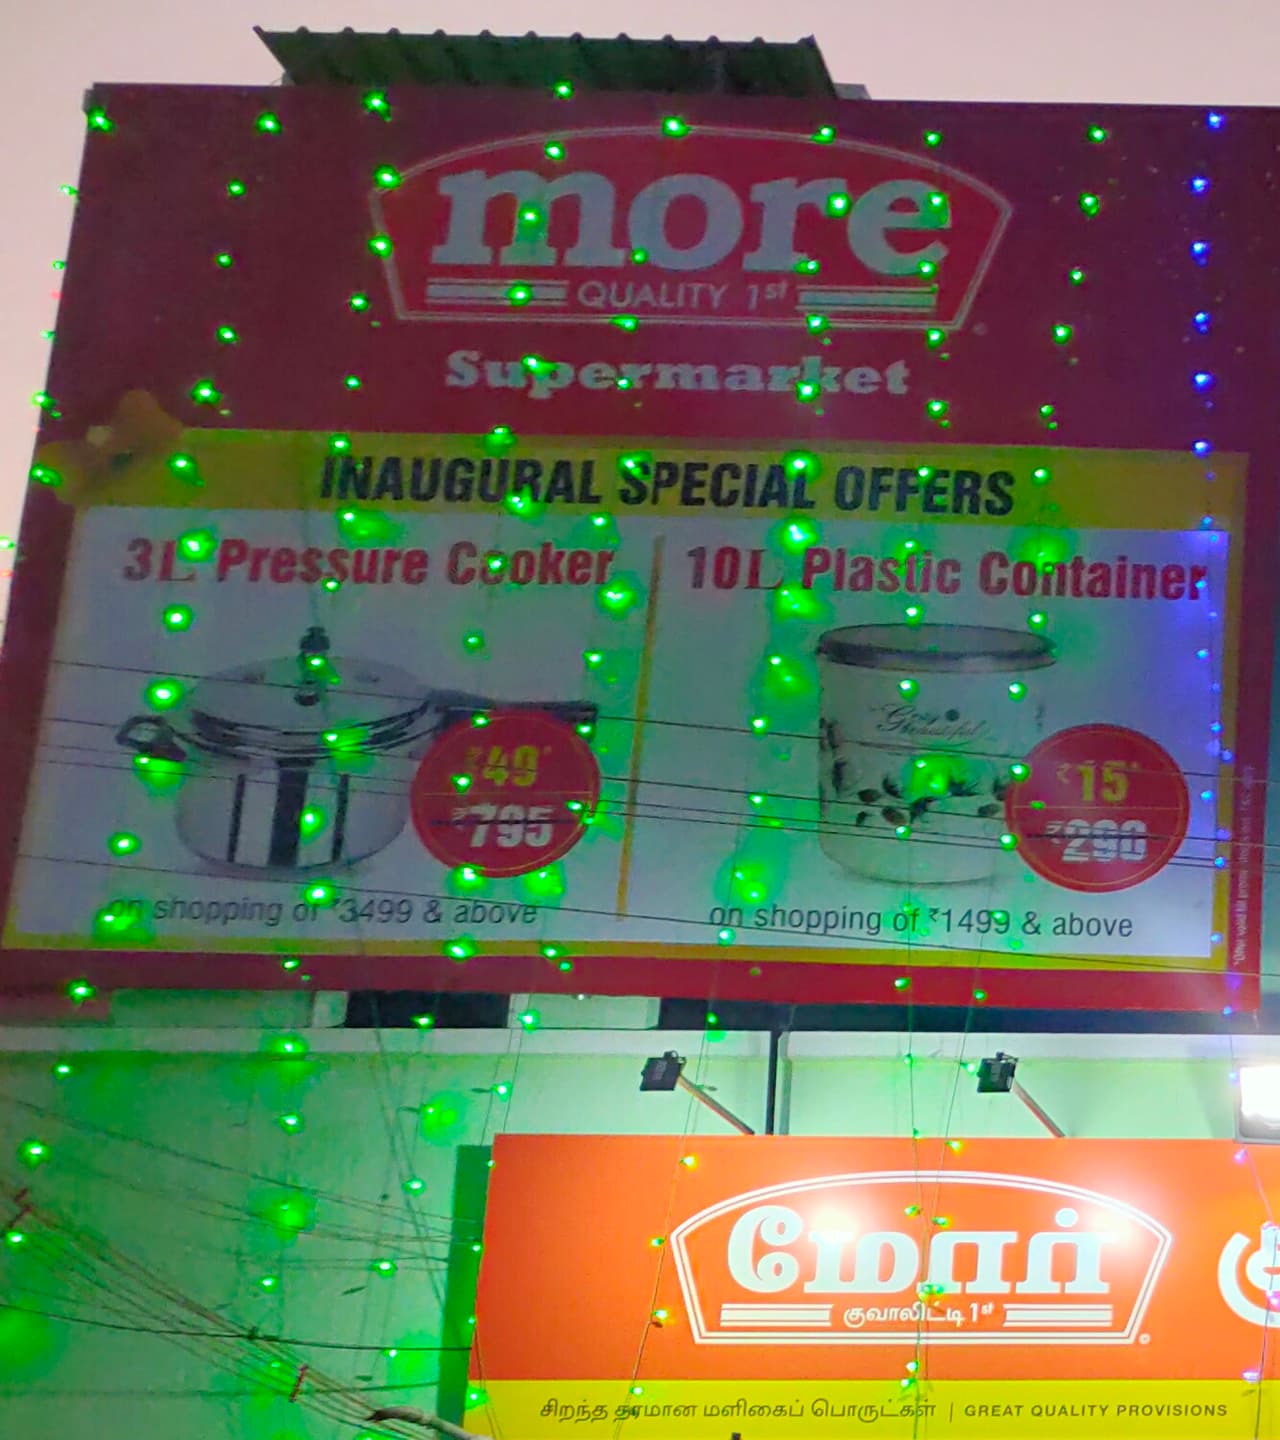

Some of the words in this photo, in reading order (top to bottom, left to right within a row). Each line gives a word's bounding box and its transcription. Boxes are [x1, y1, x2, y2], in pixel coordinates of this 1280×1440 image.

[430, 168, 952, 277] more
[577, 278, 728, 310] QUALITY
[746, 279, 788, 311] 1st
[445, 349, 912, 399] Supermarket
[320, 454, 605, 506] INAUGURAL
[617, 457, 816, 508] SPECIAL
[834, 464, 1016, 517] OFFERS
[216, 538, 429, 586] Pressure
[447, 540, 616, 586] Cooker
[688, 545, 783, 592] 10L
[802, 546, 961, 595] Plastic
[978, 550, 1209, 600] Container
[153, 896, 283, 928] shopping
[423, 899, 443, 925] &
[453, 899, 538, 925] above
[709, 908, 743, 928] on
[754, 904, 883, 936] shopping
[893, 906, 920, 935] of
[1022, 911, 1042, 937] &
[1052, 911, 1134, 938] above
[726, 1205, 1118, 1295] மோர்
[539, 1397, 609, 1423] சிறந்த
[963, 1404, 1026, 1418] GREAT
[1030, 1404, 1111, 1419] QUALITY
[1116, 1404, 1230, 1418] PROVISIONS
